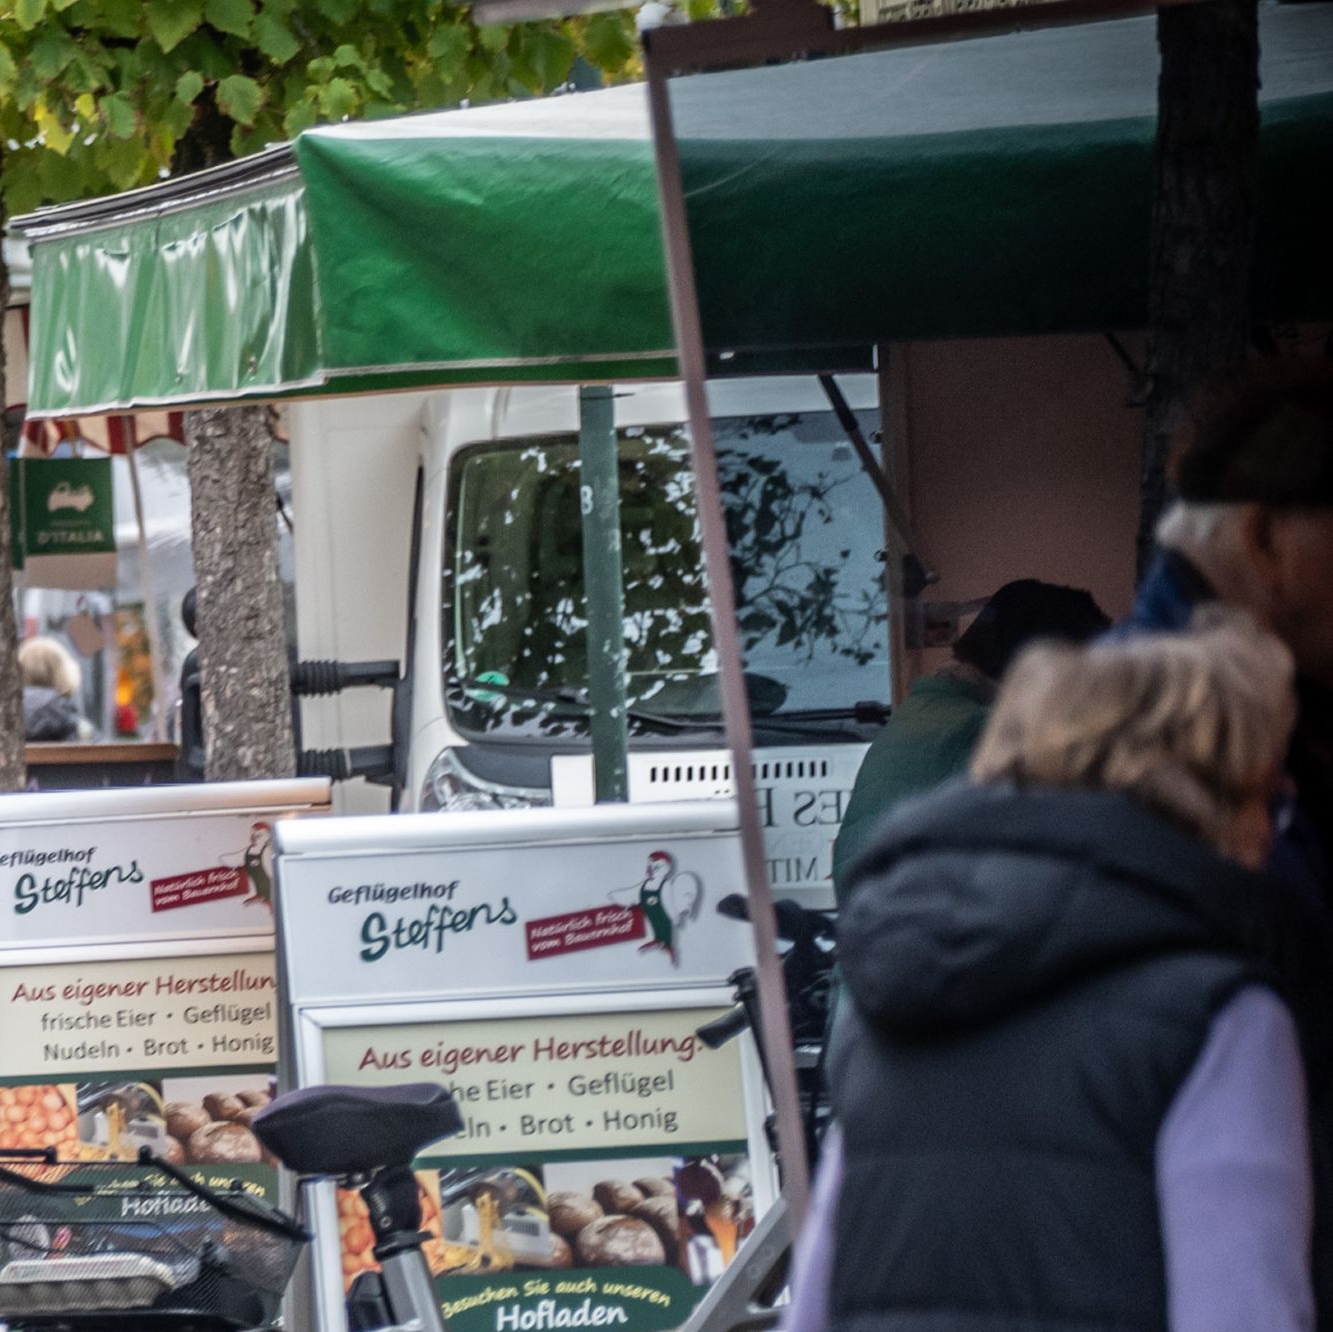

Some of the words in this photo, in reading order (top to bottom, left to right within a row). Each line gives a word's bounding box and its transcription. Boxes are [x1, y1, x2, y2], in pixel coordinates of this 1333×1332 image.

[14, 860, 145, 915] Steffens
[328, 879, 460, 905] Geflügelhof
[360, 896, 519, 962] Steffens
[530, 915, 593, 939] Natürlich
[594, 909, 633, 926] frisch
[531, 938, 562, 952] vom
[564, 918, 635, 947] Bauernhof
[10, 982, 56, 1002] Aus
[62, 978, 149, 1006] eigener
[154, 969, 277, 995] Herstellun
[41, 1008, 112, 1032] frische
[116, 1009, 156, 1028] Eier
[183, 1001, 272, 1027] Geflügel
[44, 1039, 120, 1062] Nudeln
[143, 1037, 189, 1057] Brot
[212, 1033, 275, 1055] Honig
[358, 1047, 412, 1071] Aus
[420, 1041, 525, 1075] eigener
[487, 1080, 535, 1100] Eier
[568, 1069, 674, 1099] Geflügel
[520, 1113, 575, 1136] Brot
[603, 1107, 679, 1133] Honig
[523, 1278, 551, 1297] Sie
[555, 1276, 597, 1294] auch
[601, 1281, 672, 1308] unseren
[496, 1296, 629, 1332] Hofladen
